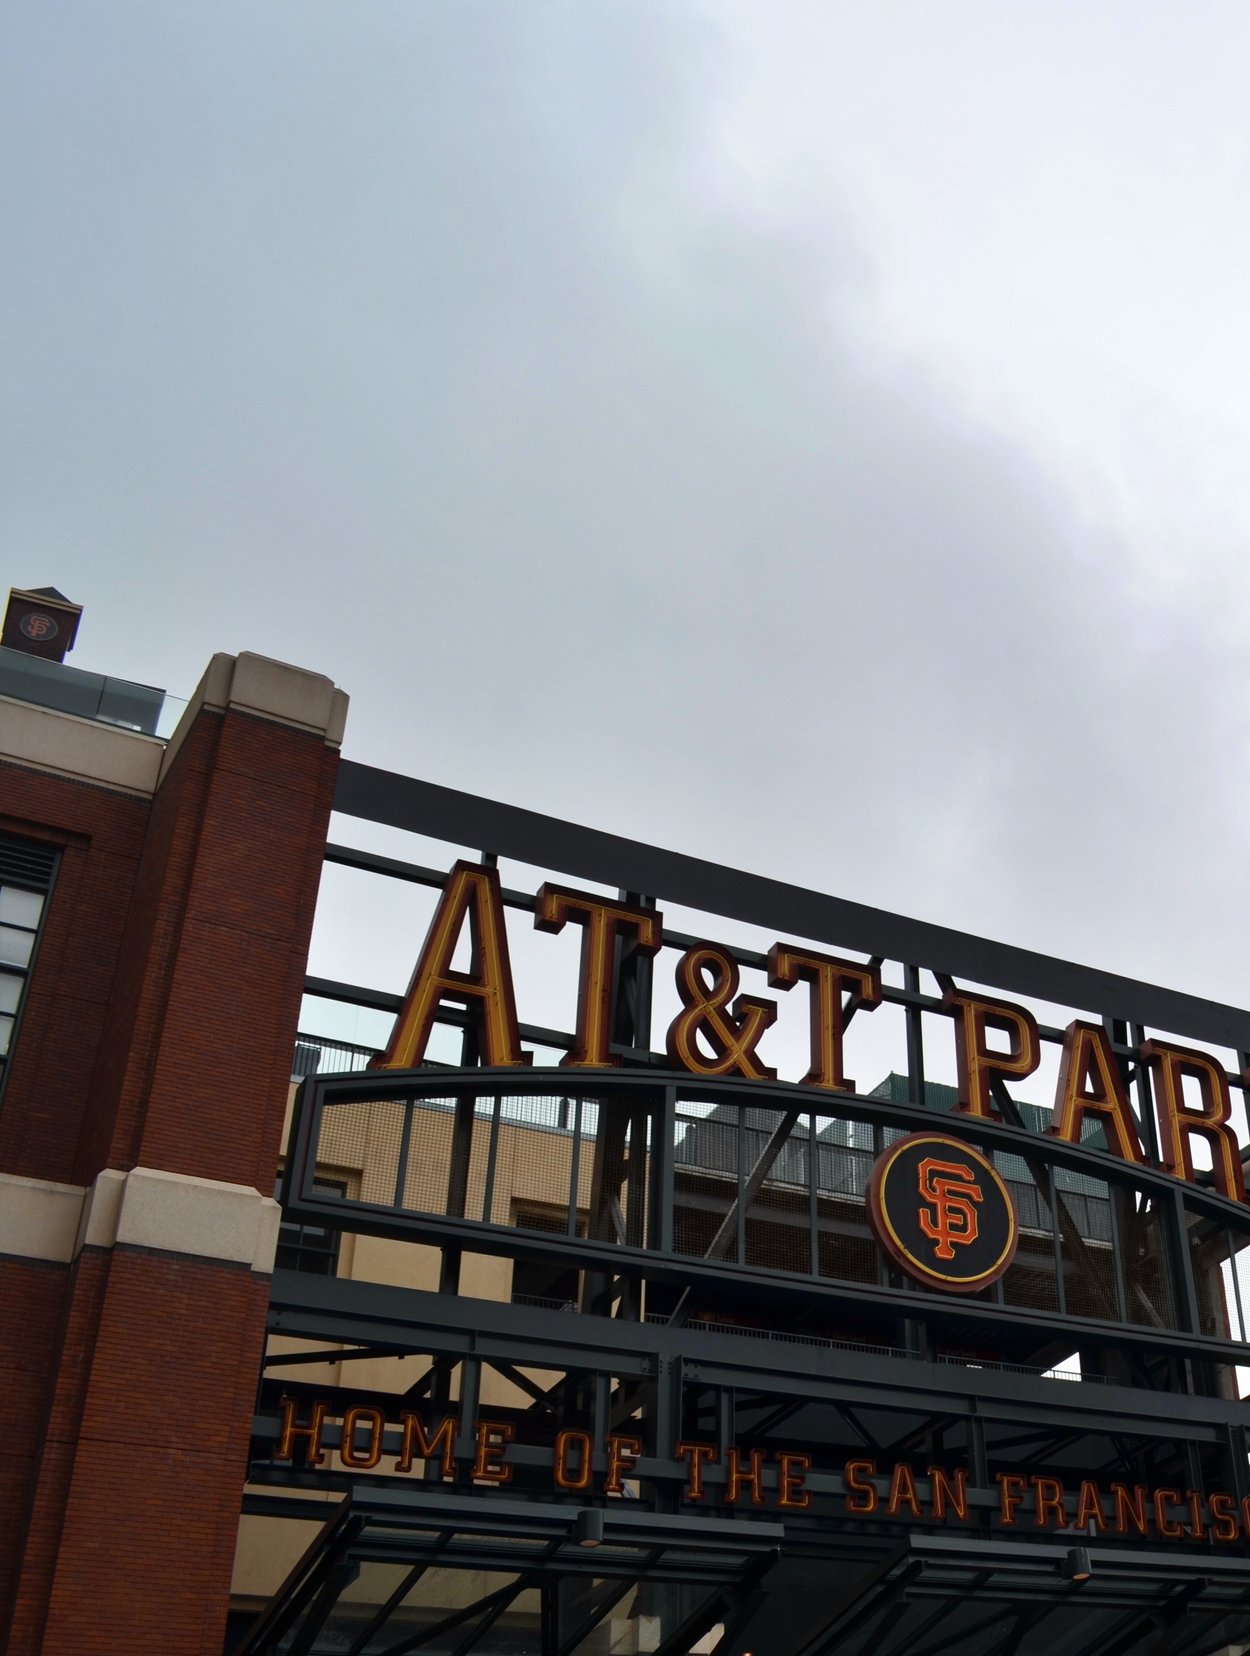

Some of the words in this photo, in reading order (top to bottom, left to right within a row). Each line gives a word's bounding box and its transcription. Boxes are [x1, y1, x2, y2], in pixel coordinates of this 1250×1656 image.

[367, 859, 882, 1092] AT&T
[918, 1157, 984, 1260] SF
[279, 1395, 516, 1483] HOME
[553, 1428, 643, 1493] OF
[675, 1440, 812, 1508] THE
[845, 1459, 969, 1521] SAN
